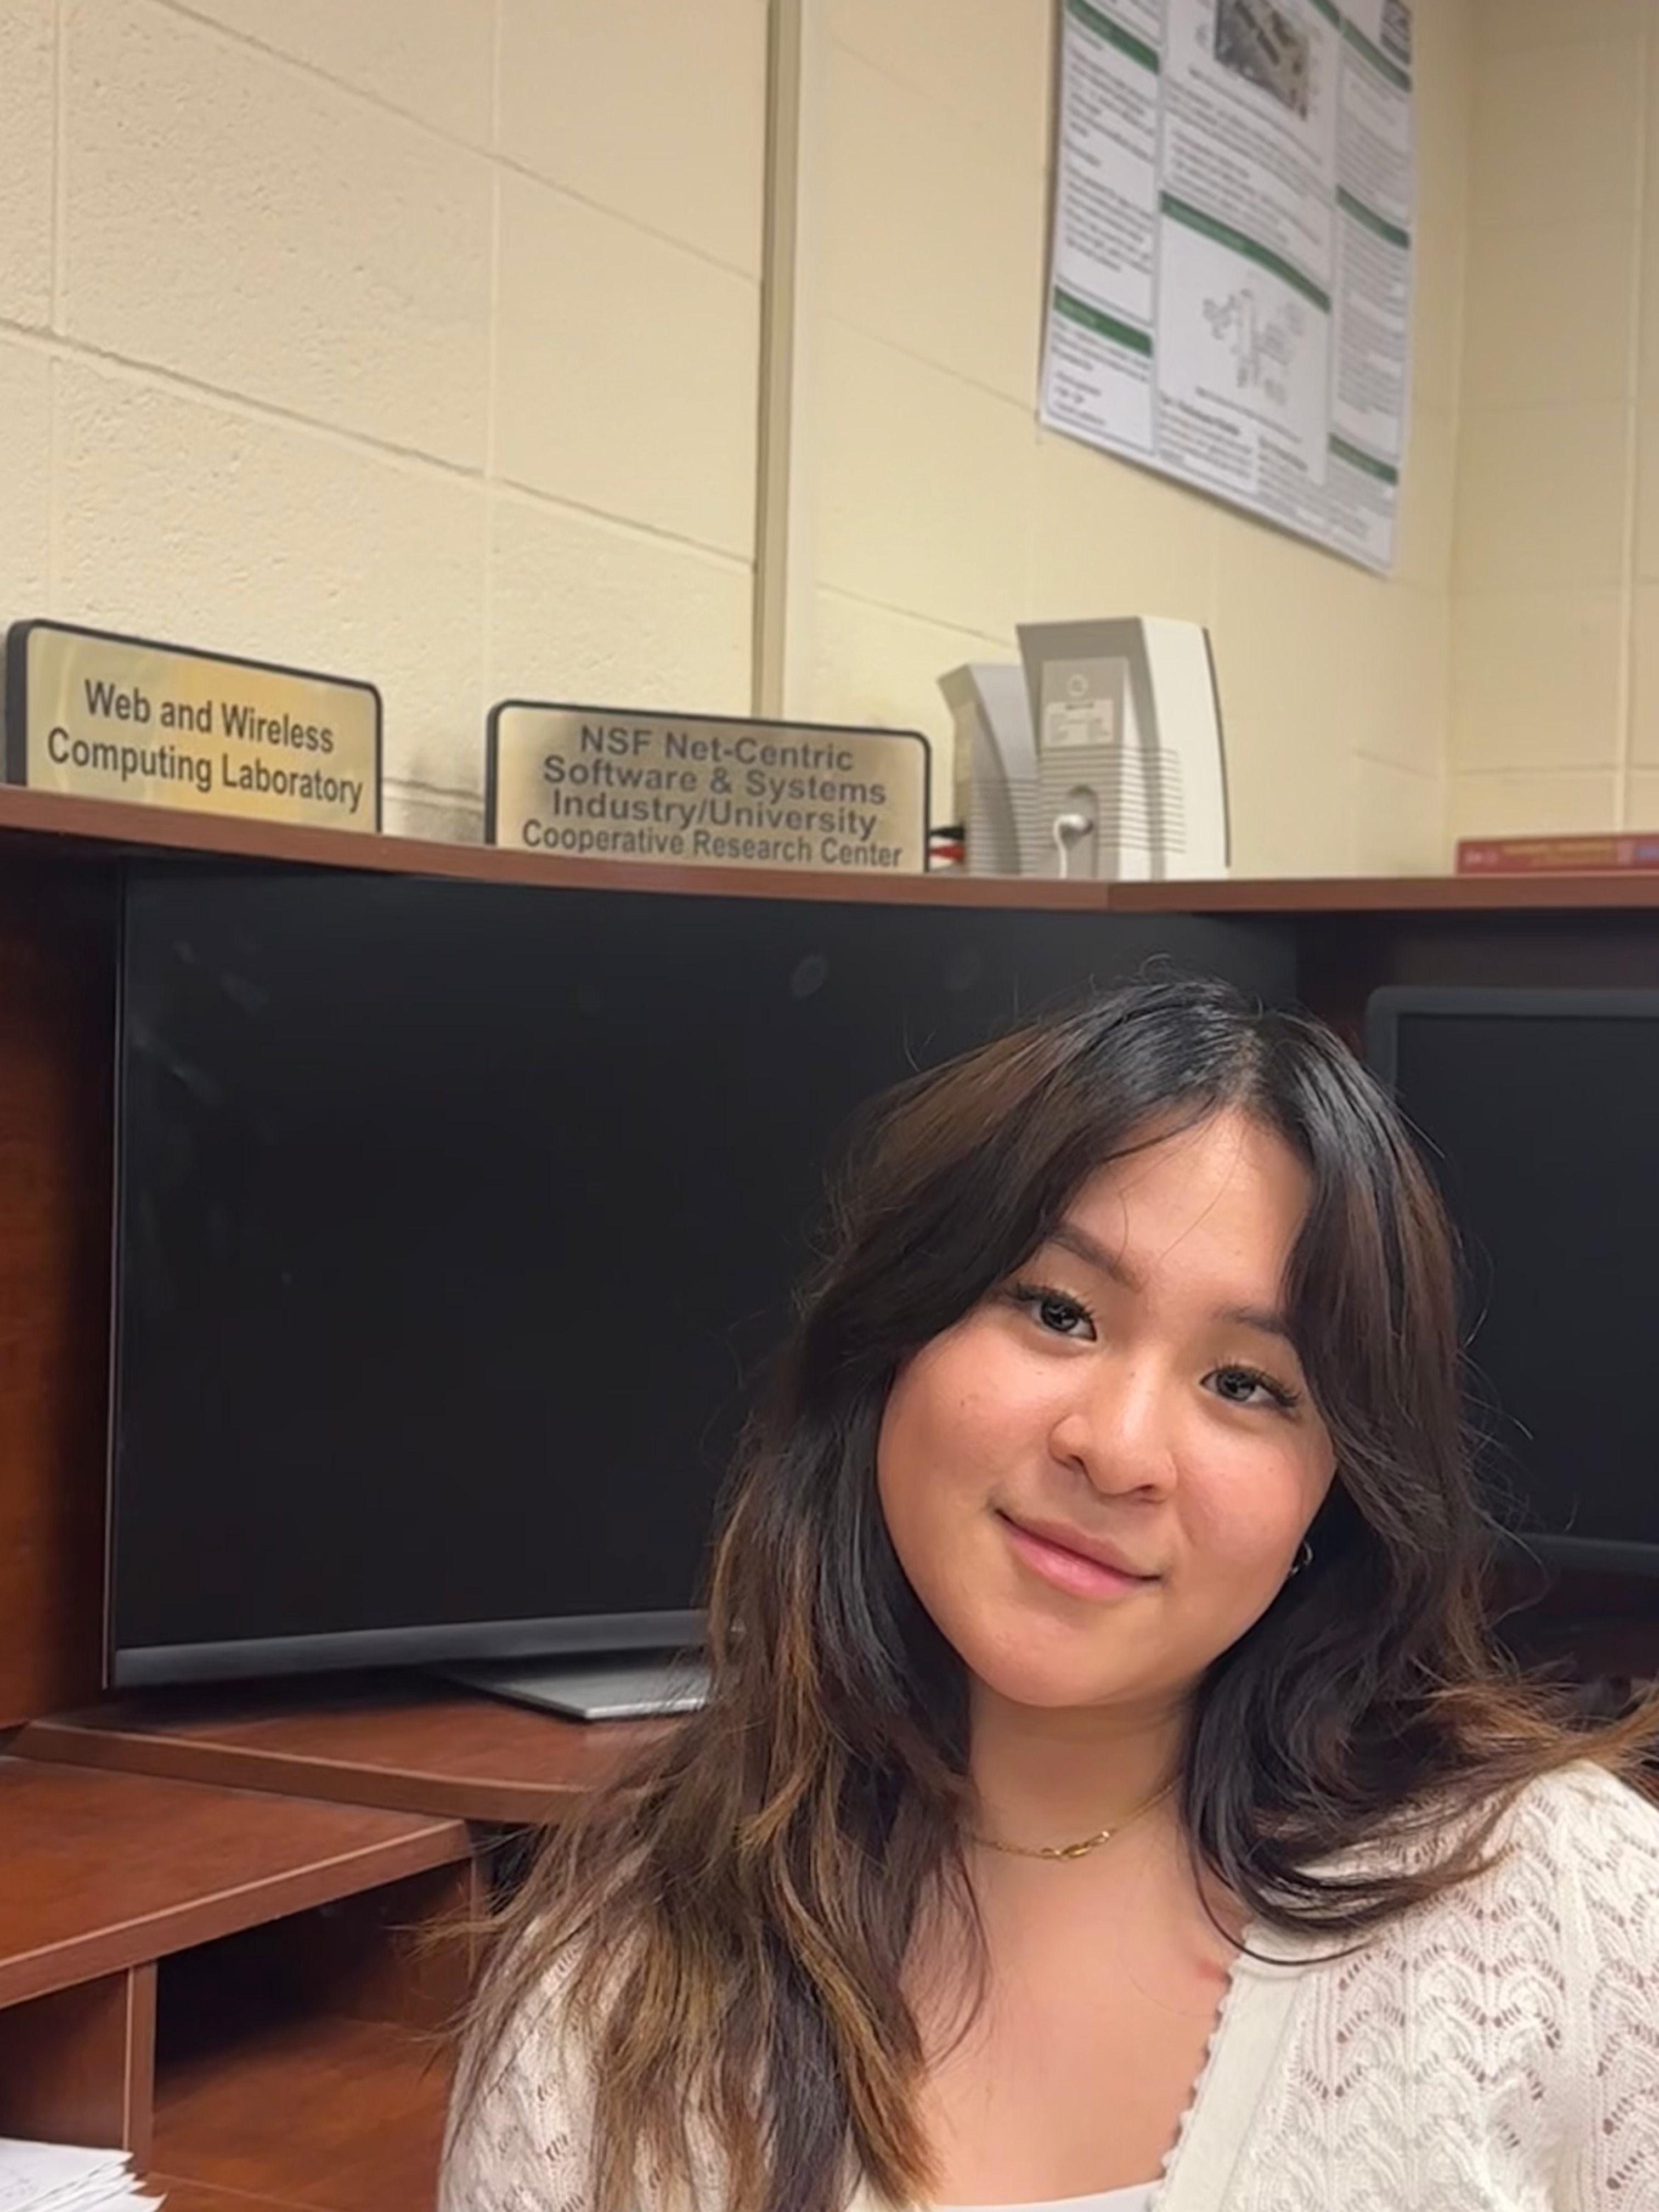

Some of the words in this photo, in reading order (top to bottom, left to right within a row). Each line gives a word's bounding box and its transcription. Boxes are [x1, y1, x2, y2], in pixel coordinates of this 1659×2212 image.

[85, 679, 151, 723] Web
[161, 700, 212, 733] and
[222, 703, 334, 753] Wireless
[48, 727, 212, 792] Computing
[222, 754, 362, 813] Laboratory
[580, 725, 652, 755] NSF
[665, 732, 854, 771] Net-Centric
[544, 755, 697, 792] Software
[710, 766, 732, 794] &
[746, 769, 887, 805] Systems
[554, 789, 877, 842] Industry/University
[523, 820, 684, 855] Cooperative
[693, 831, 812, 863] Research
[822, 838, 902, 867] Center
